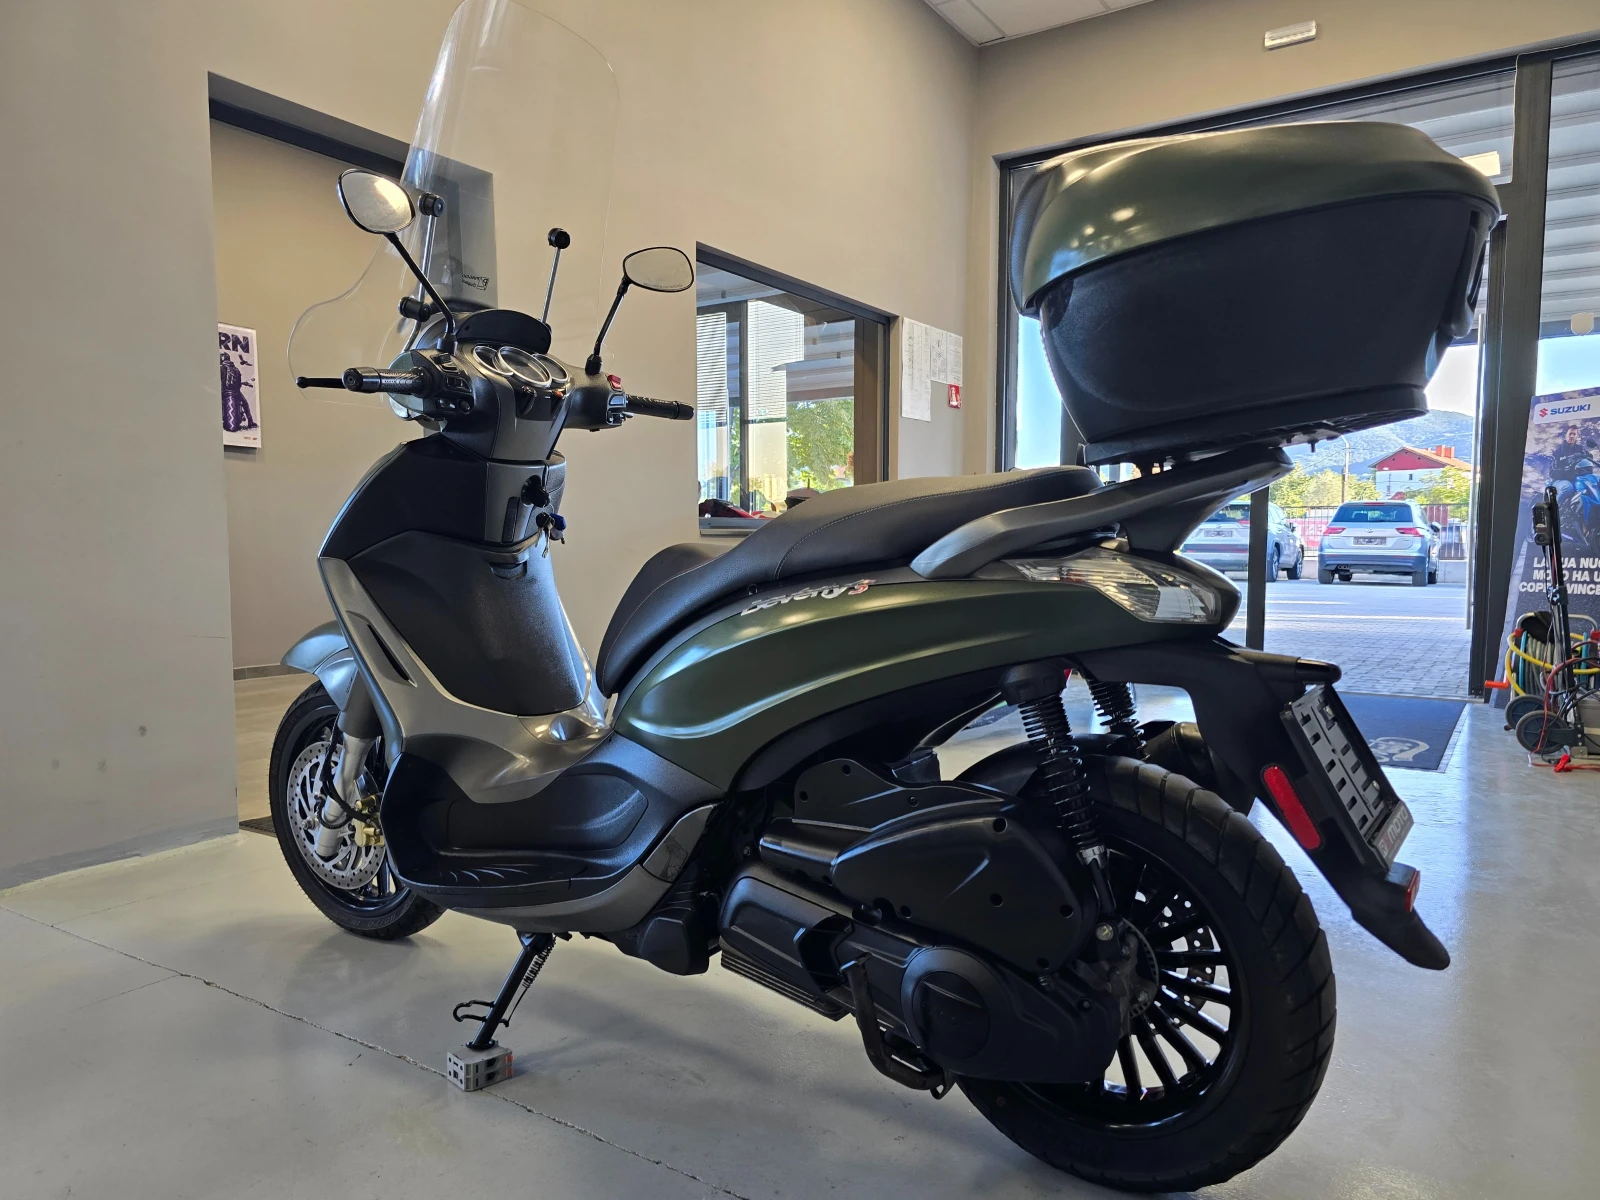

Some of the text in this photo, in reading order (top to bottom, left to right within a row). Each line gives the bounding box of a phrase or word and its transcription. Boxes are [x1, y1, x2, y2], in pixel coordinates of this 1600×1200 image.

[1550, 404, 1591, 415] SUZUKI
[1560, 557, 1577, 569] UA
[1532, 569, 1570, 581] MOO
[1571, 570, 1590, 582] HA
